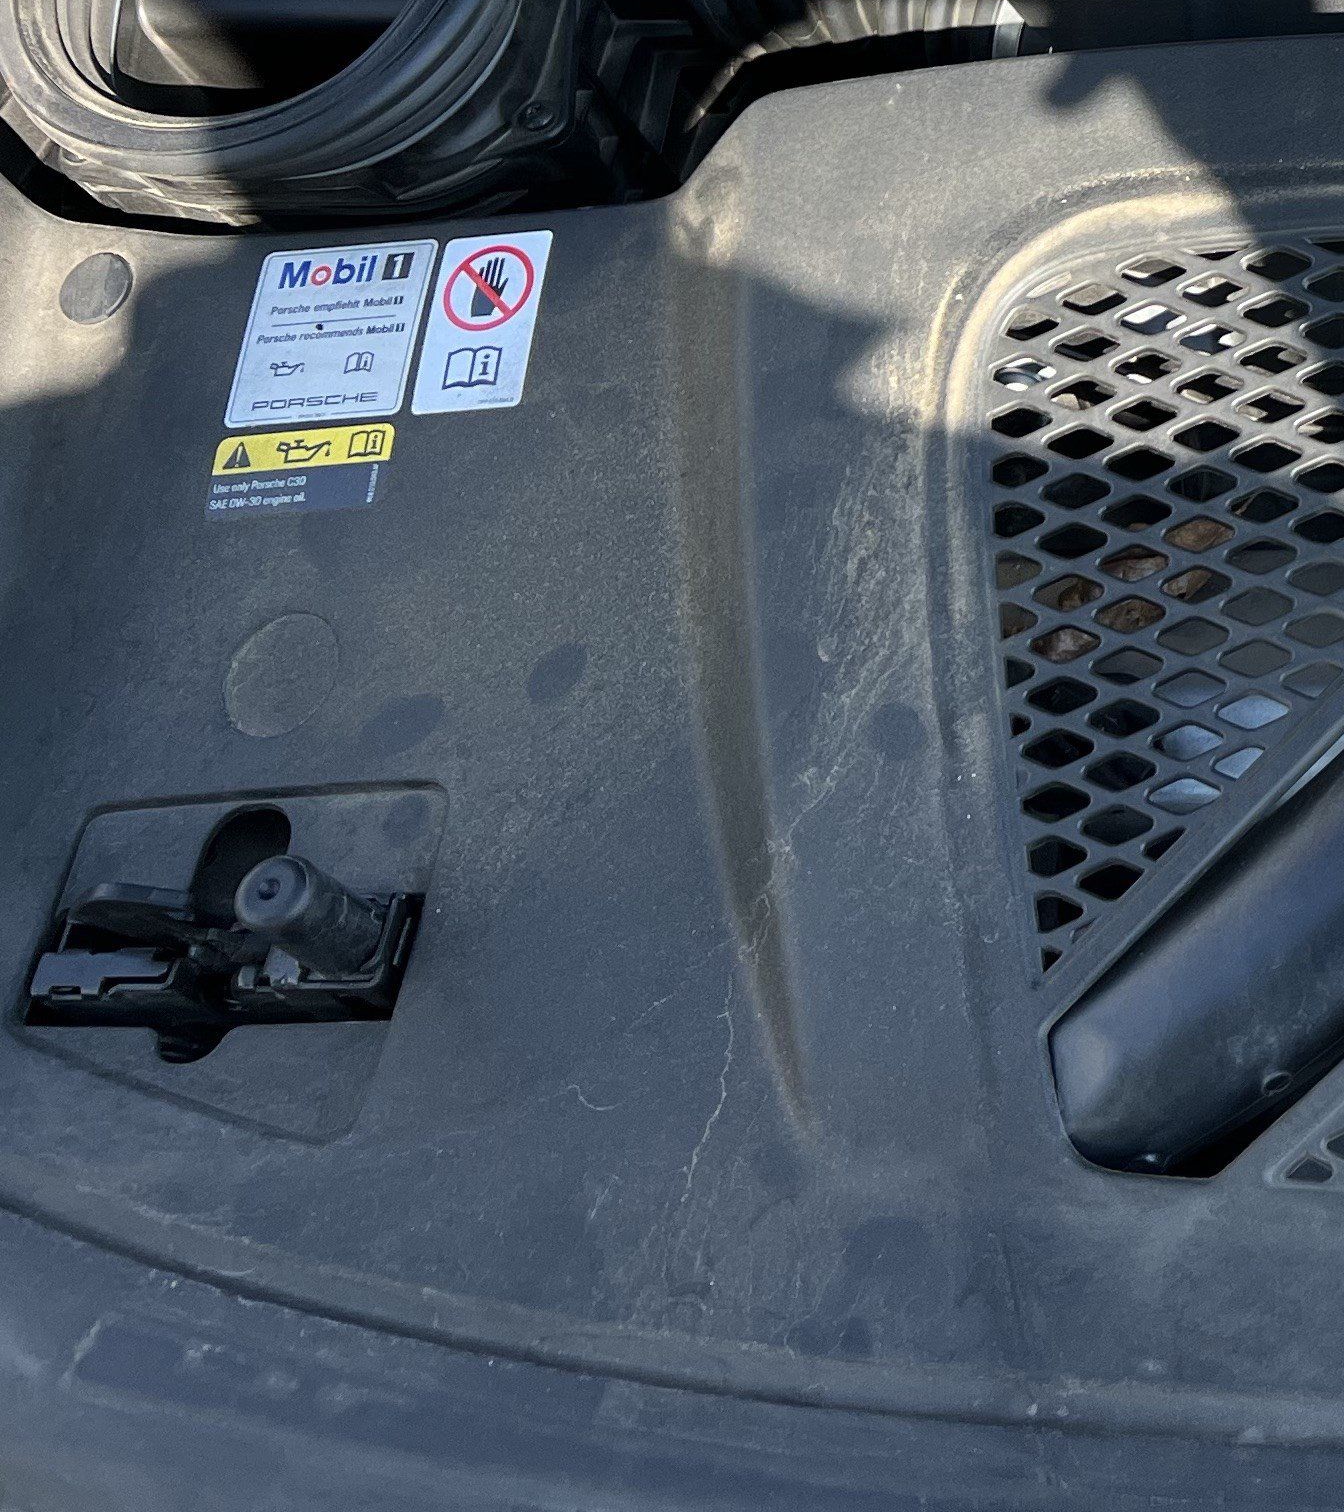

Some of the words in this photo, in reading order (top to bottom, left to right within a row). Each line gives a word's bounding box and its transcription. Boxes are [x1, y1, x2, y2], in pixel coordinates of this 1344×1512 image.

[278, 254, 378, 289] Mobil
[386, 253, 410, 279] 1
[270, 304, 310, 316] Porsche
[314, 298, 360, 312] empfiehlt
[363, 296, 392, 307] Mobil
[256, 332, 296, 345] Porsche
[299, 326, 364, 340] recommends
[366, 324, 394, 335] Mobil
[251, 391, 379, 411] PORSCHE
[213, 480, 230, 494] Use
[231, 480, 251, 494] only
[251, 477, 285, 491] Porsche
[286, 475, 307, 487] C30
[209, 498, 228, 510] SAE
[262, 494, 292, 507] engine
